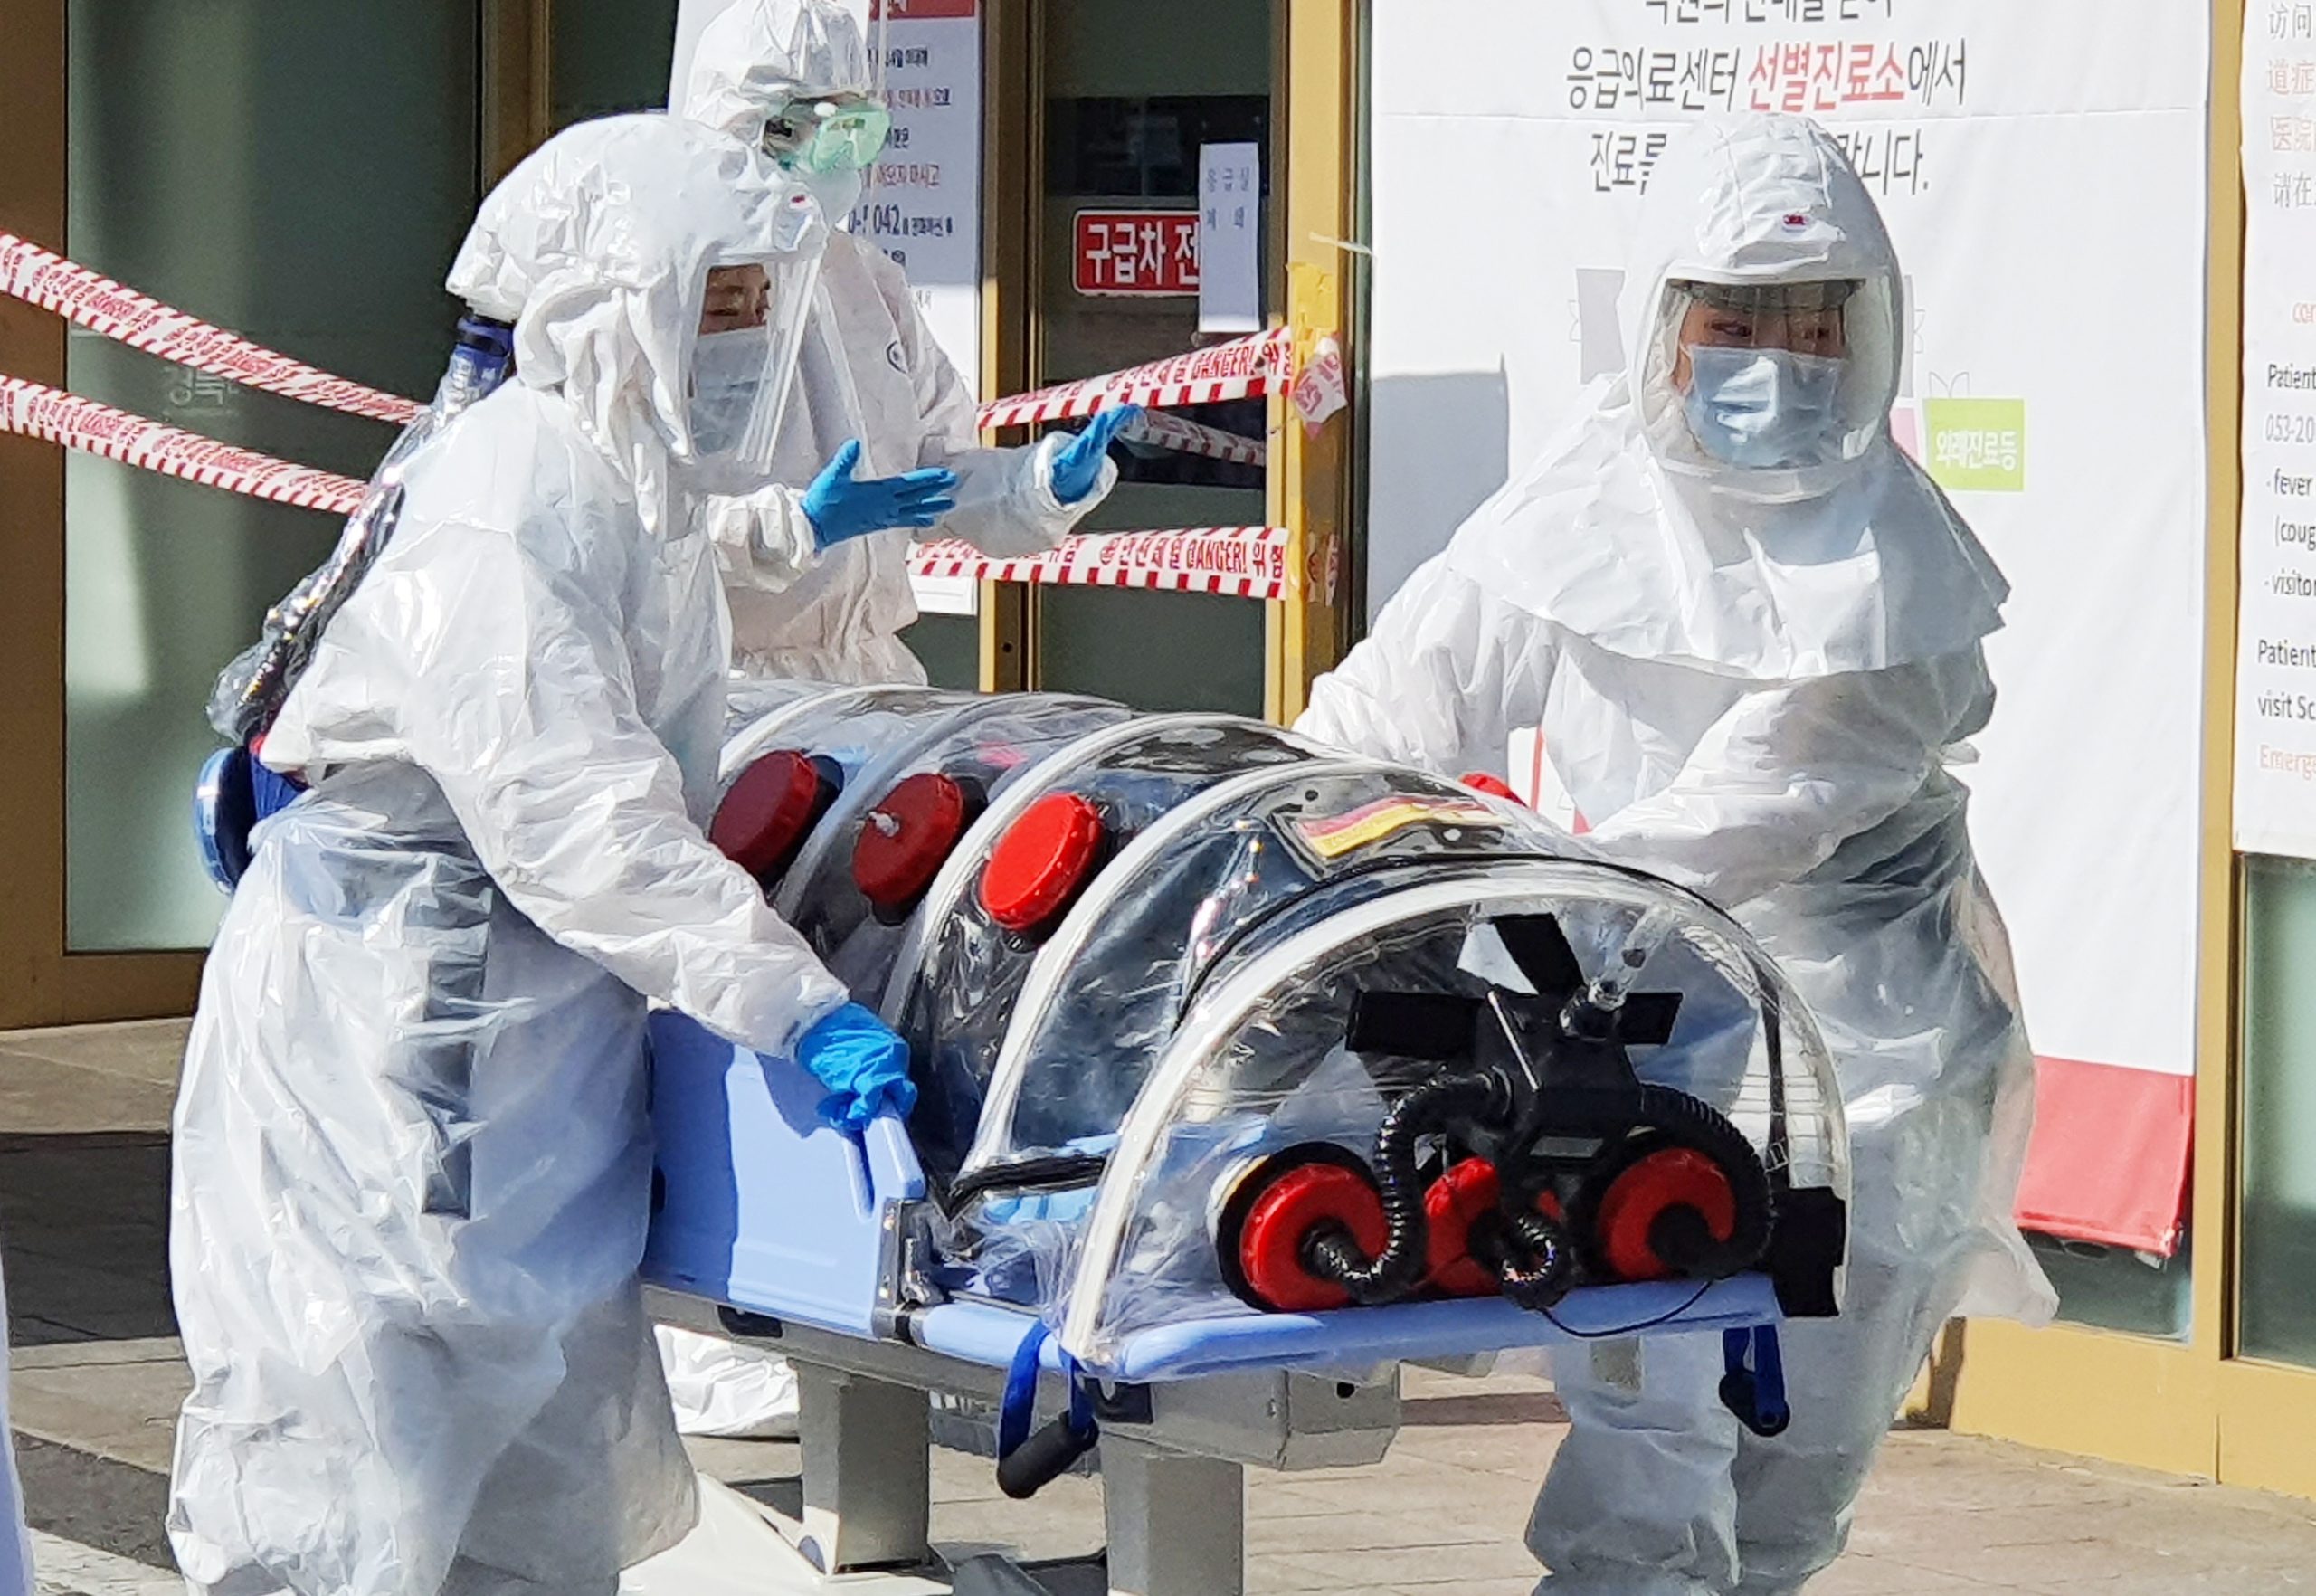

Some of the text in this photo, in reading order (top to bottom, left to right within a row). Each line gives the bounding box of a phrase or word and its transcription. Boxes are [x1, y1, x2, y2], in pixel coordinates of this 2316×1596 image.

[1566, 38, 1966, 112] 응급의료센터 선별진료소에서
[1087, 222, 1167, 285] 구급차
[1187, 538, 1248, 574] DANGER!
[2258, 689, 2292, 718] visit
